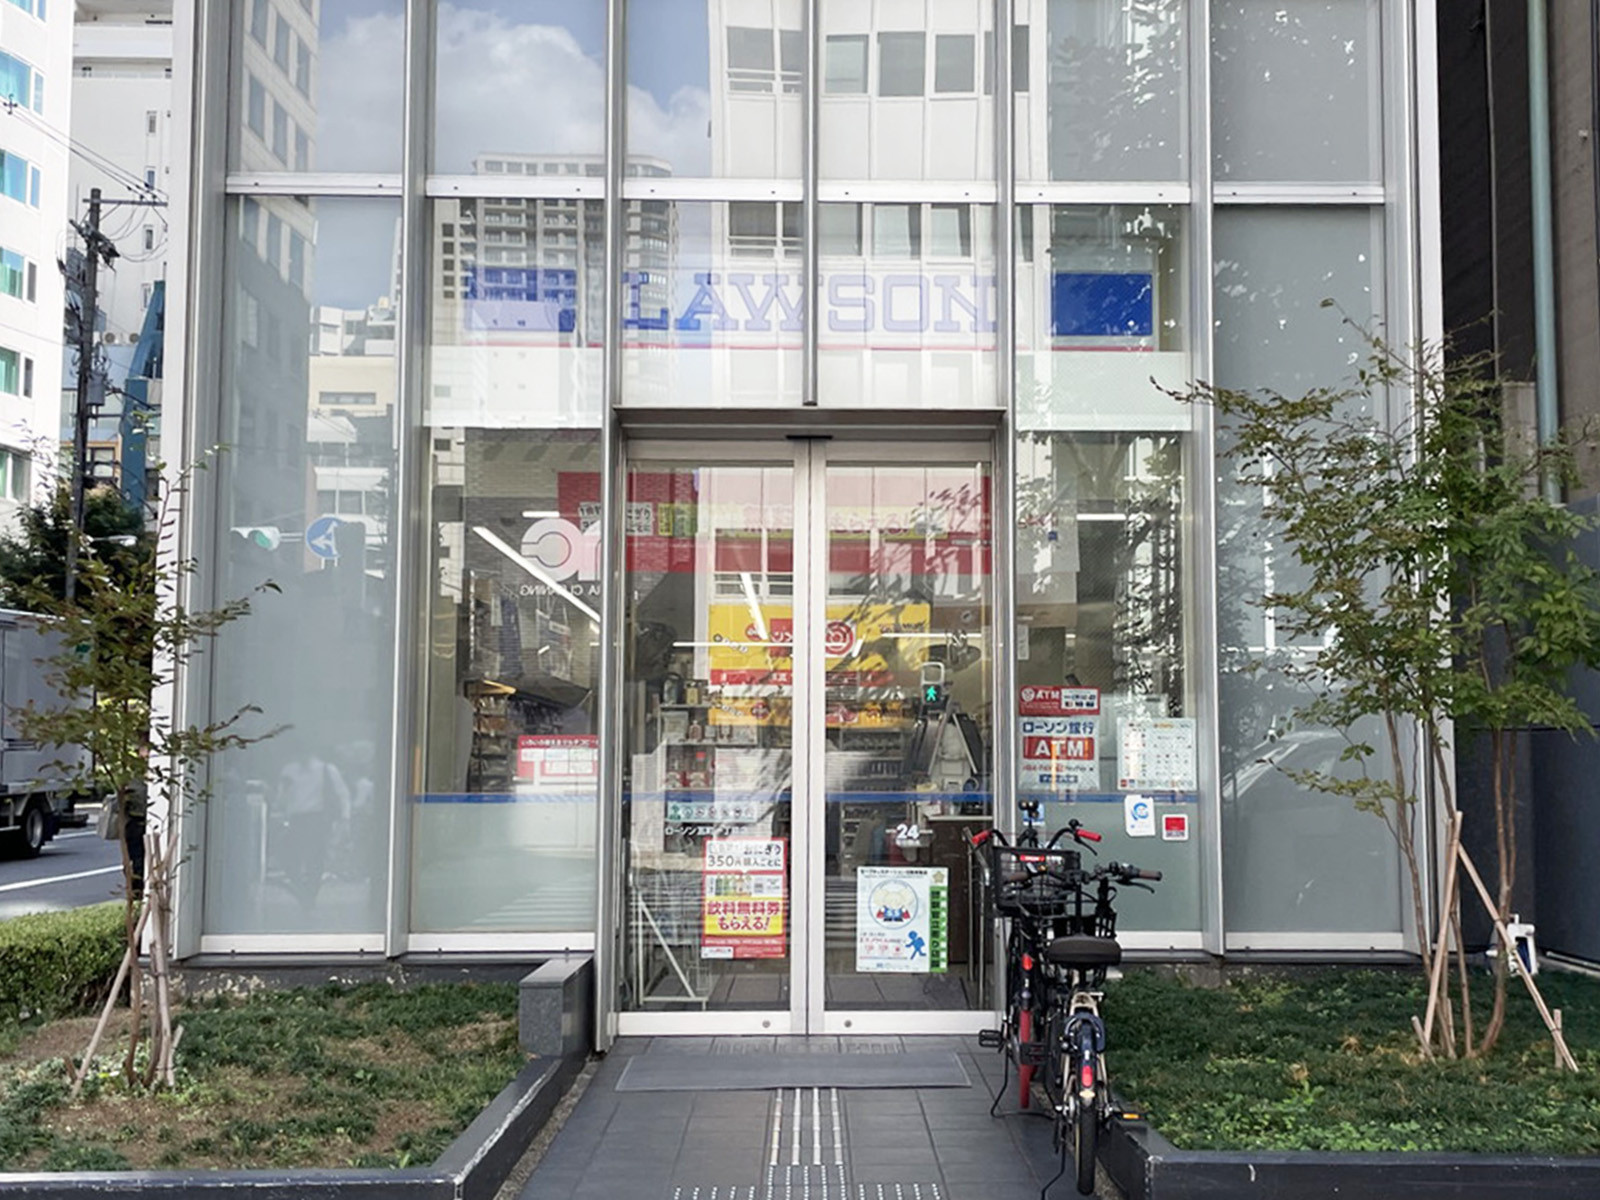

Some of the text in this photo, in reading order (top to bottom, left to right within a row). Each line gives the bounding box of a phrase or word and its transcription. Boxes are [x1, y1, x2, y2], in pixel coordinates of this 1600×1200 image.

[621, 271, 998, 333] LAWSON
[1036, 689, 1060, 700] ATM
[1022, 721, 1094, 735] ローソン銀行
[1034, 739, 1084, 757] ATM
[896, 823, 920, 839] 24
[707, 900, 780, 916] 飲料無料券
[717, 916, 771, 931] もらえる!
